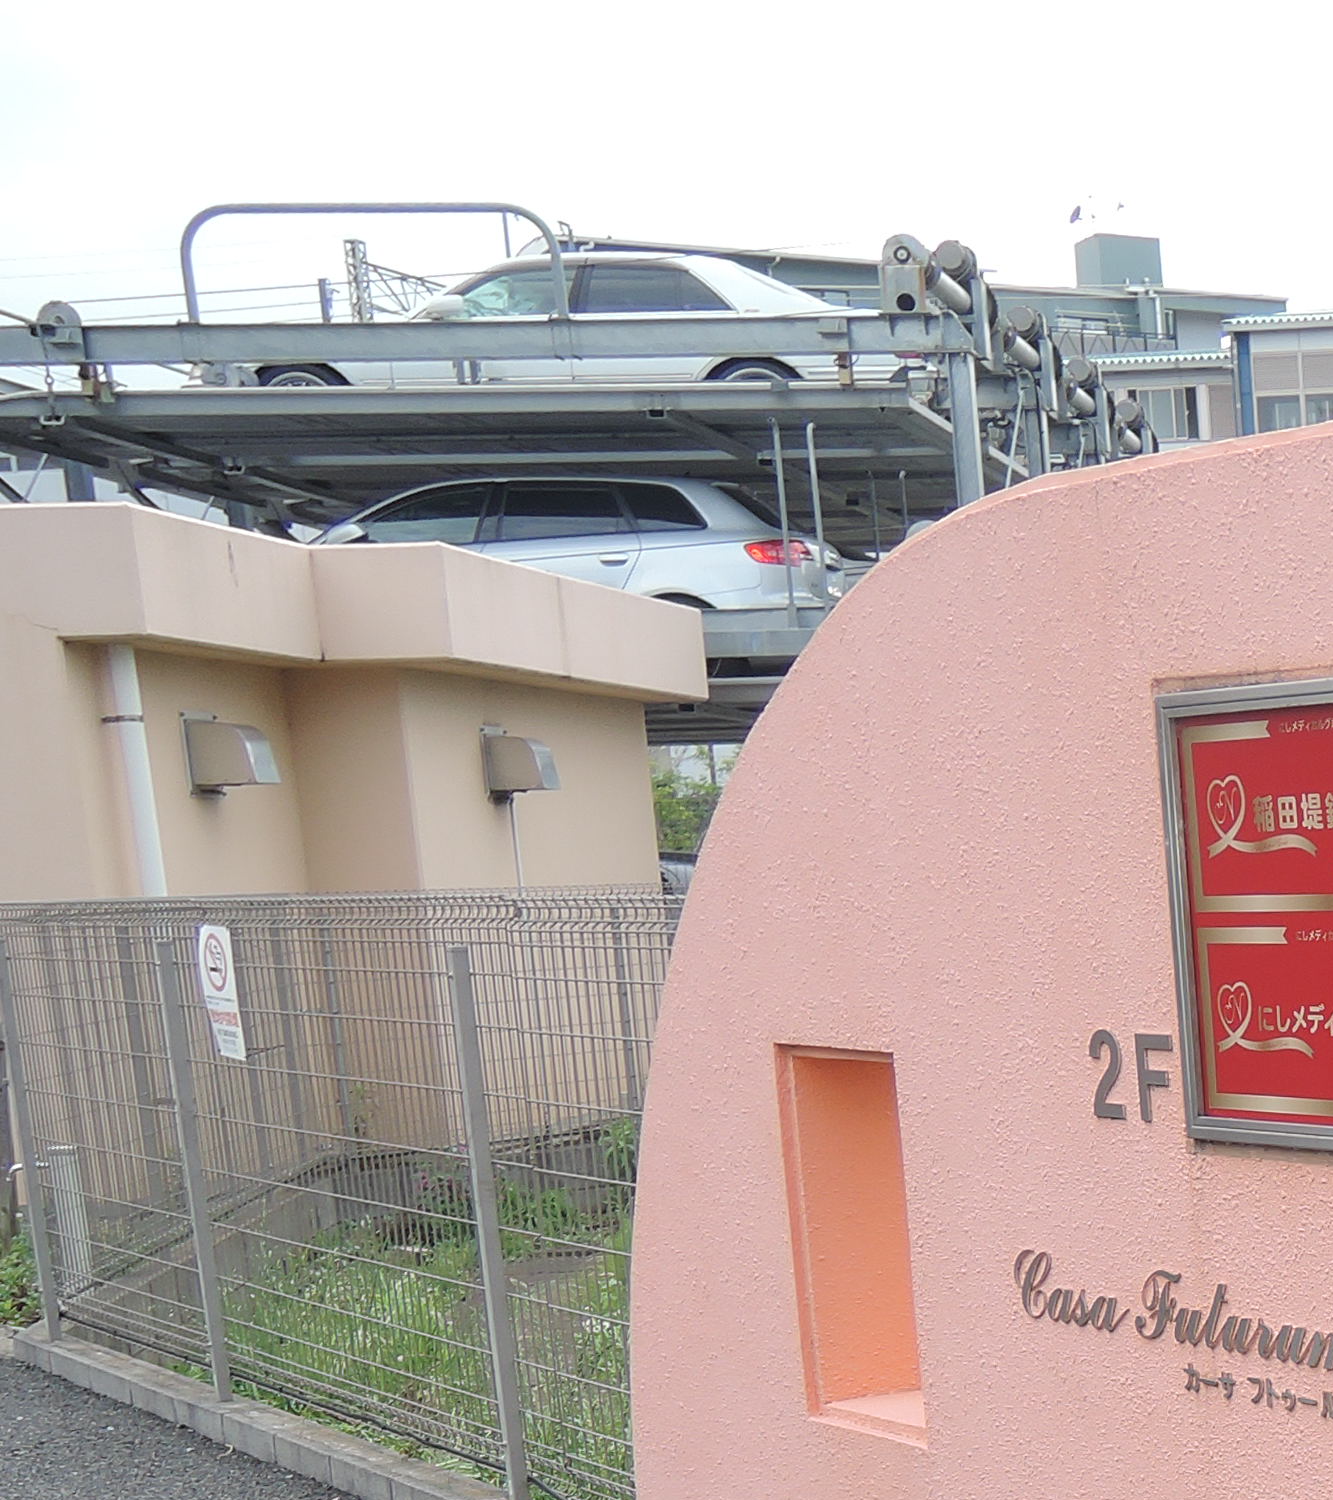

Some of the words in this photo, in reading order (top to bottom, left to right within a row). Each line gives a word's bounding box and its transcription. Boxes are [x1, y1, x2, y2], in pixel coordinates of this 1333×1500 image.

[1087, 1029, 1174, 1122] 2F
[1013, 1249, 1130, 1333] Casa
[1183, 1363, 1236, 1400] カーサ
